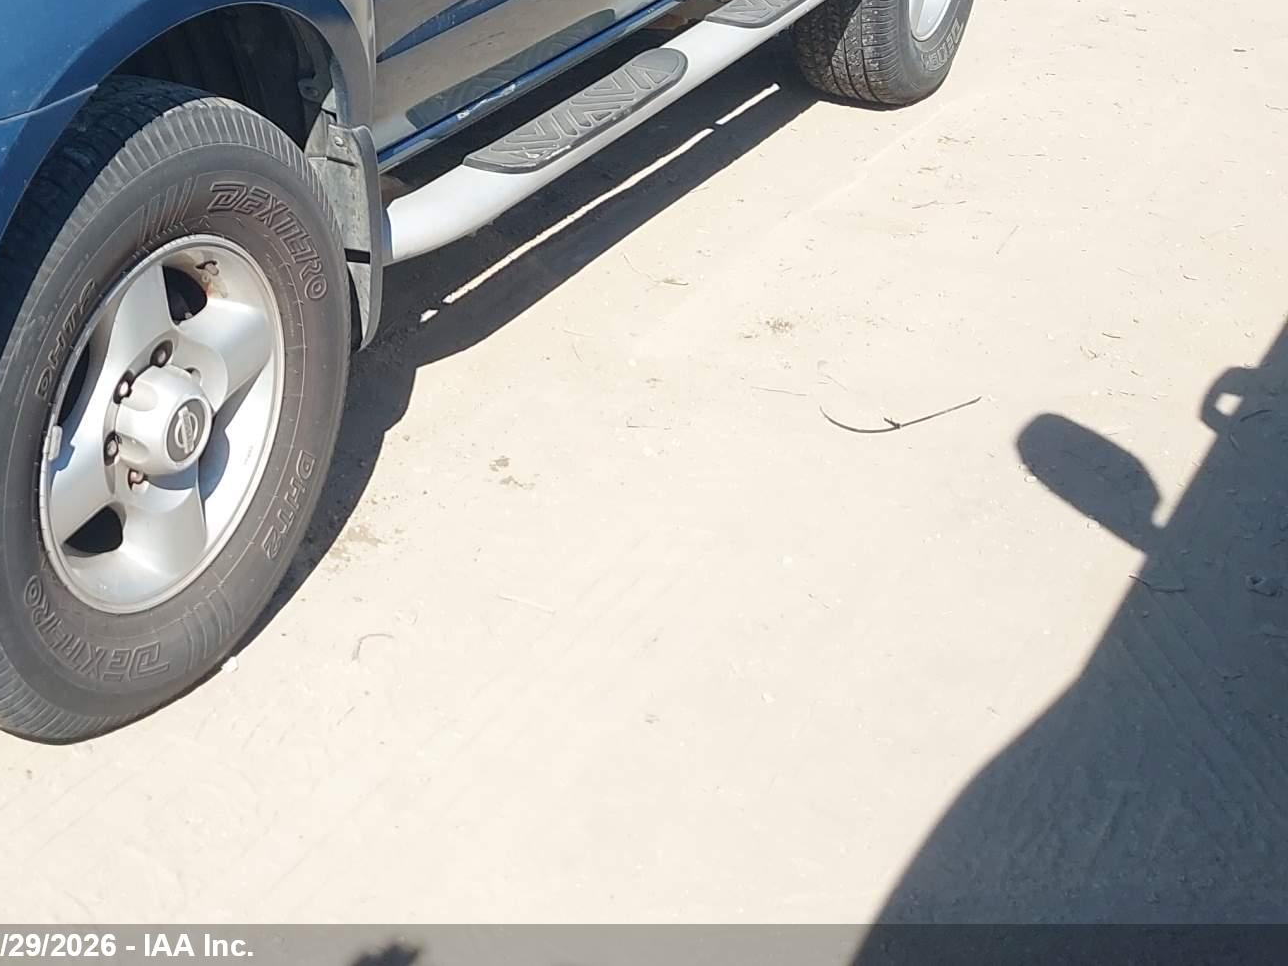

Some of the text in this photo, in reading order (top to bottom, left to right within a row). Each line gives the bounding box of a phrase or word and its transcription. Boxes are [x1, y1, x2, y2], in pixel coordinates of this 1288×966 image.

[206, 180, 328, 300] DEXTERO
[261, 449, 317, 560] DHT2
[23, 575, 170, 682] DEXTERO
